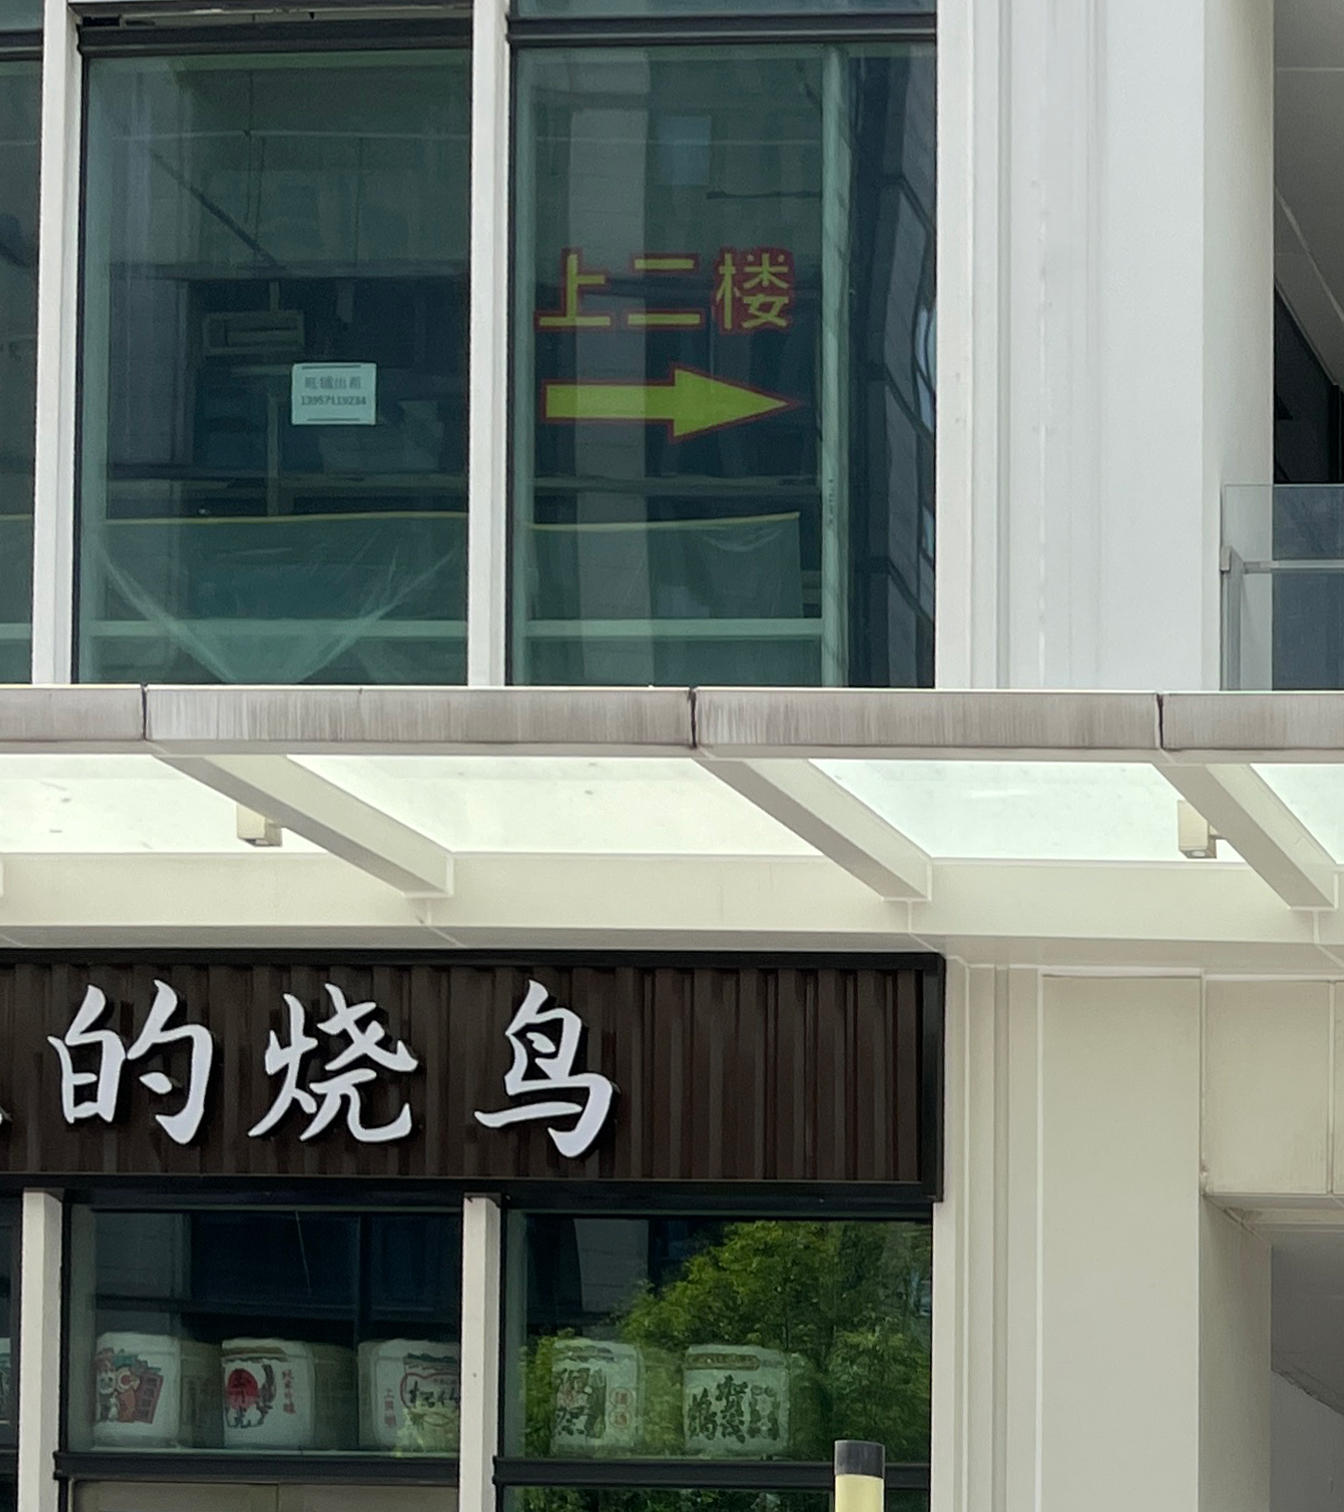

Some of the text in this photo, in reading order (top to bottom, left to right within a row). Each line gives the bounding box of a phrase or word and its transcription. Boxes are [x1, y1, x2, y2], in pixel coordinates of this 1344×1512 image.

[535, 248, 796, 332] 上二楼
[47, 979, 618, 1159] 的烧鸟
